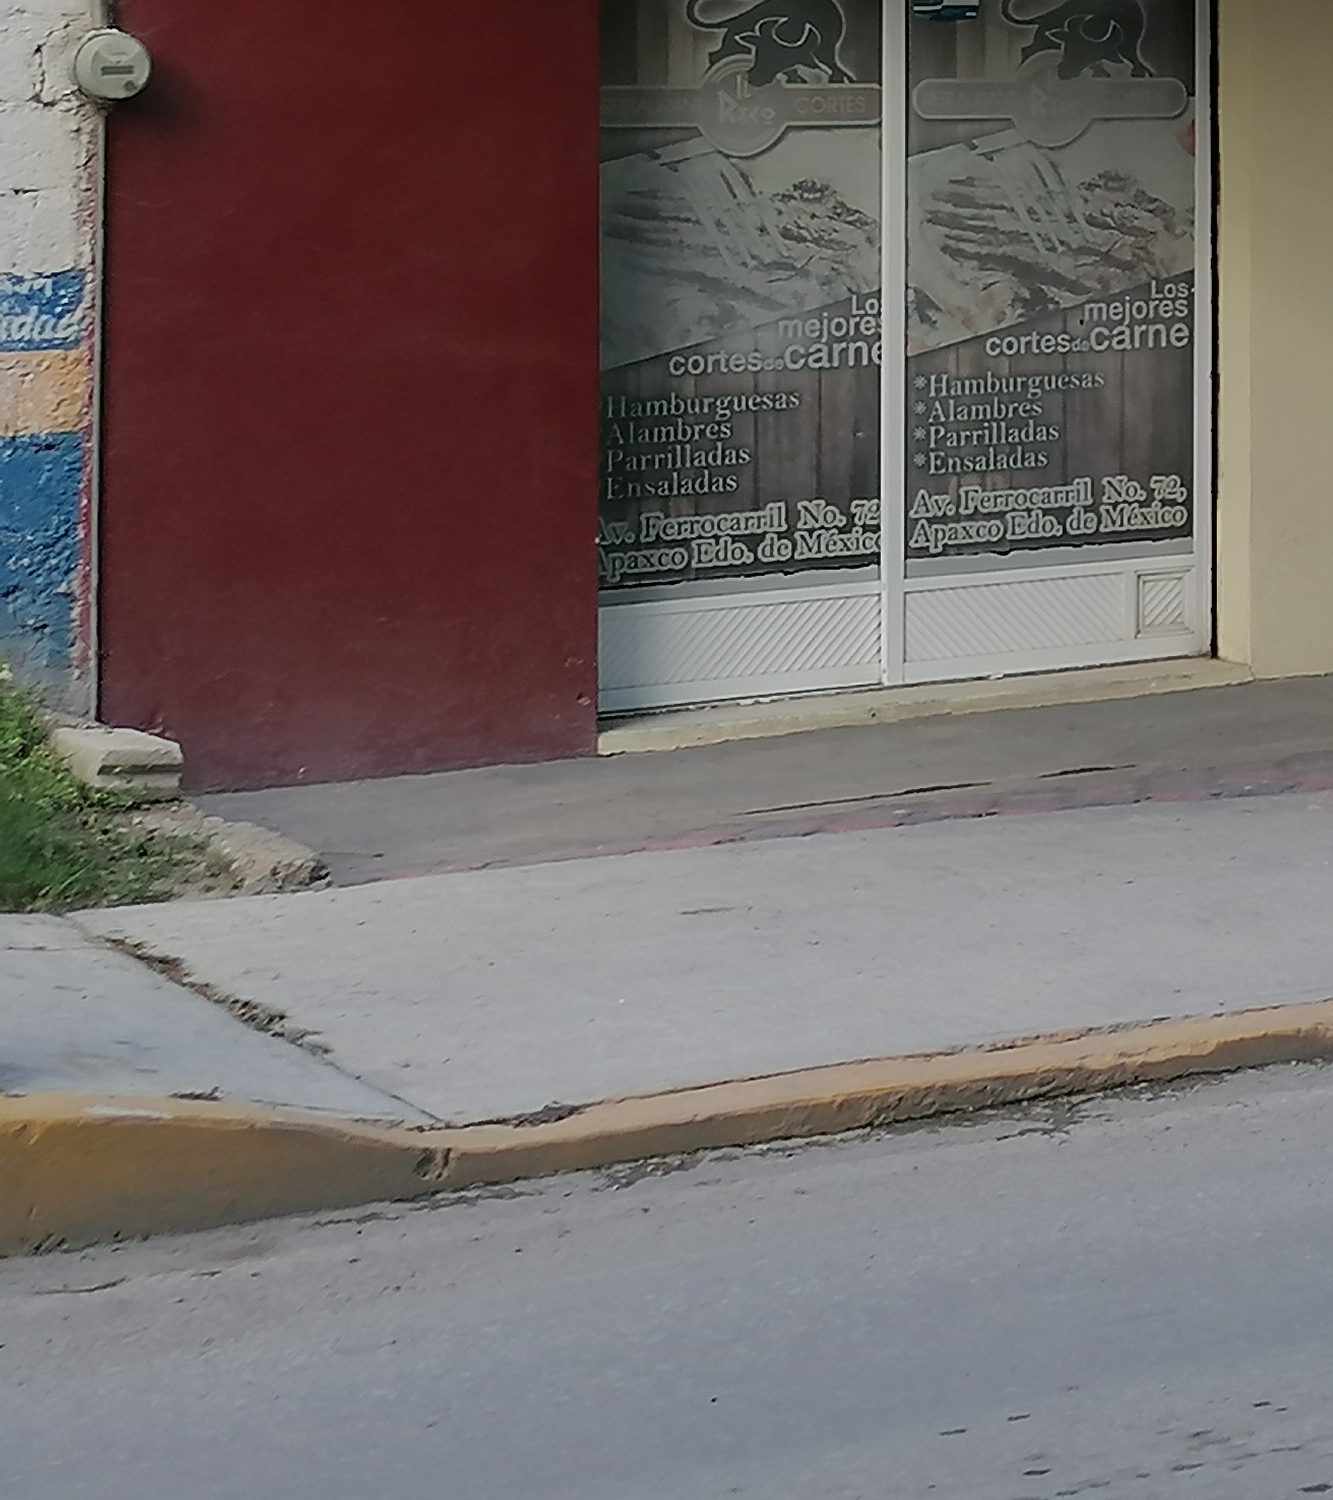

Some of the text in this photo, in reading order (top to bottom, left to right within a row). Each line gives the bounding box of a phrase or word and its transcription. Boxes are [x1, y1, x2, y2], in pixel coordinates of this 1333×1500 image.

[794, 96, 866, 114] CORTES
[1150, 280, 1189, 299] Los
[851, 295, 881, 315] Lo
[1083, 296, 1189, 325] mejores
[985, 332, 1072, 357] cortes
[1089, 322, 1190, 351] carne
[668, 350, 764, 376] cortes
[927, 370, 1105, 399] Hamburguesas
[605, 390, 801, 421] Hamburguesas
[927, 397, 1043, 424] Alambres
[605, 418, 732, 445] Alambres
[927, 420, 1060, 449] Parrilladas
[606, 441, 752, 473] Parrilladas
[927, 445, 1049, 475] Ensaladas
[606, 469, 738, 500] Ensaladas
[908, 489, 956, 518] Av.
[958, 477, 1094, 515] Ferrocarril
[1101, 475, 1148, 503] No.
[640, 501, 788, 543] Ferrocarril
[797, 499, 847, 529] No.
[908, 500, 1188, 554] Apaxco Edo. de México
[691, 535, 754, 569] Edo.
[757, 533, 792, 563] de
